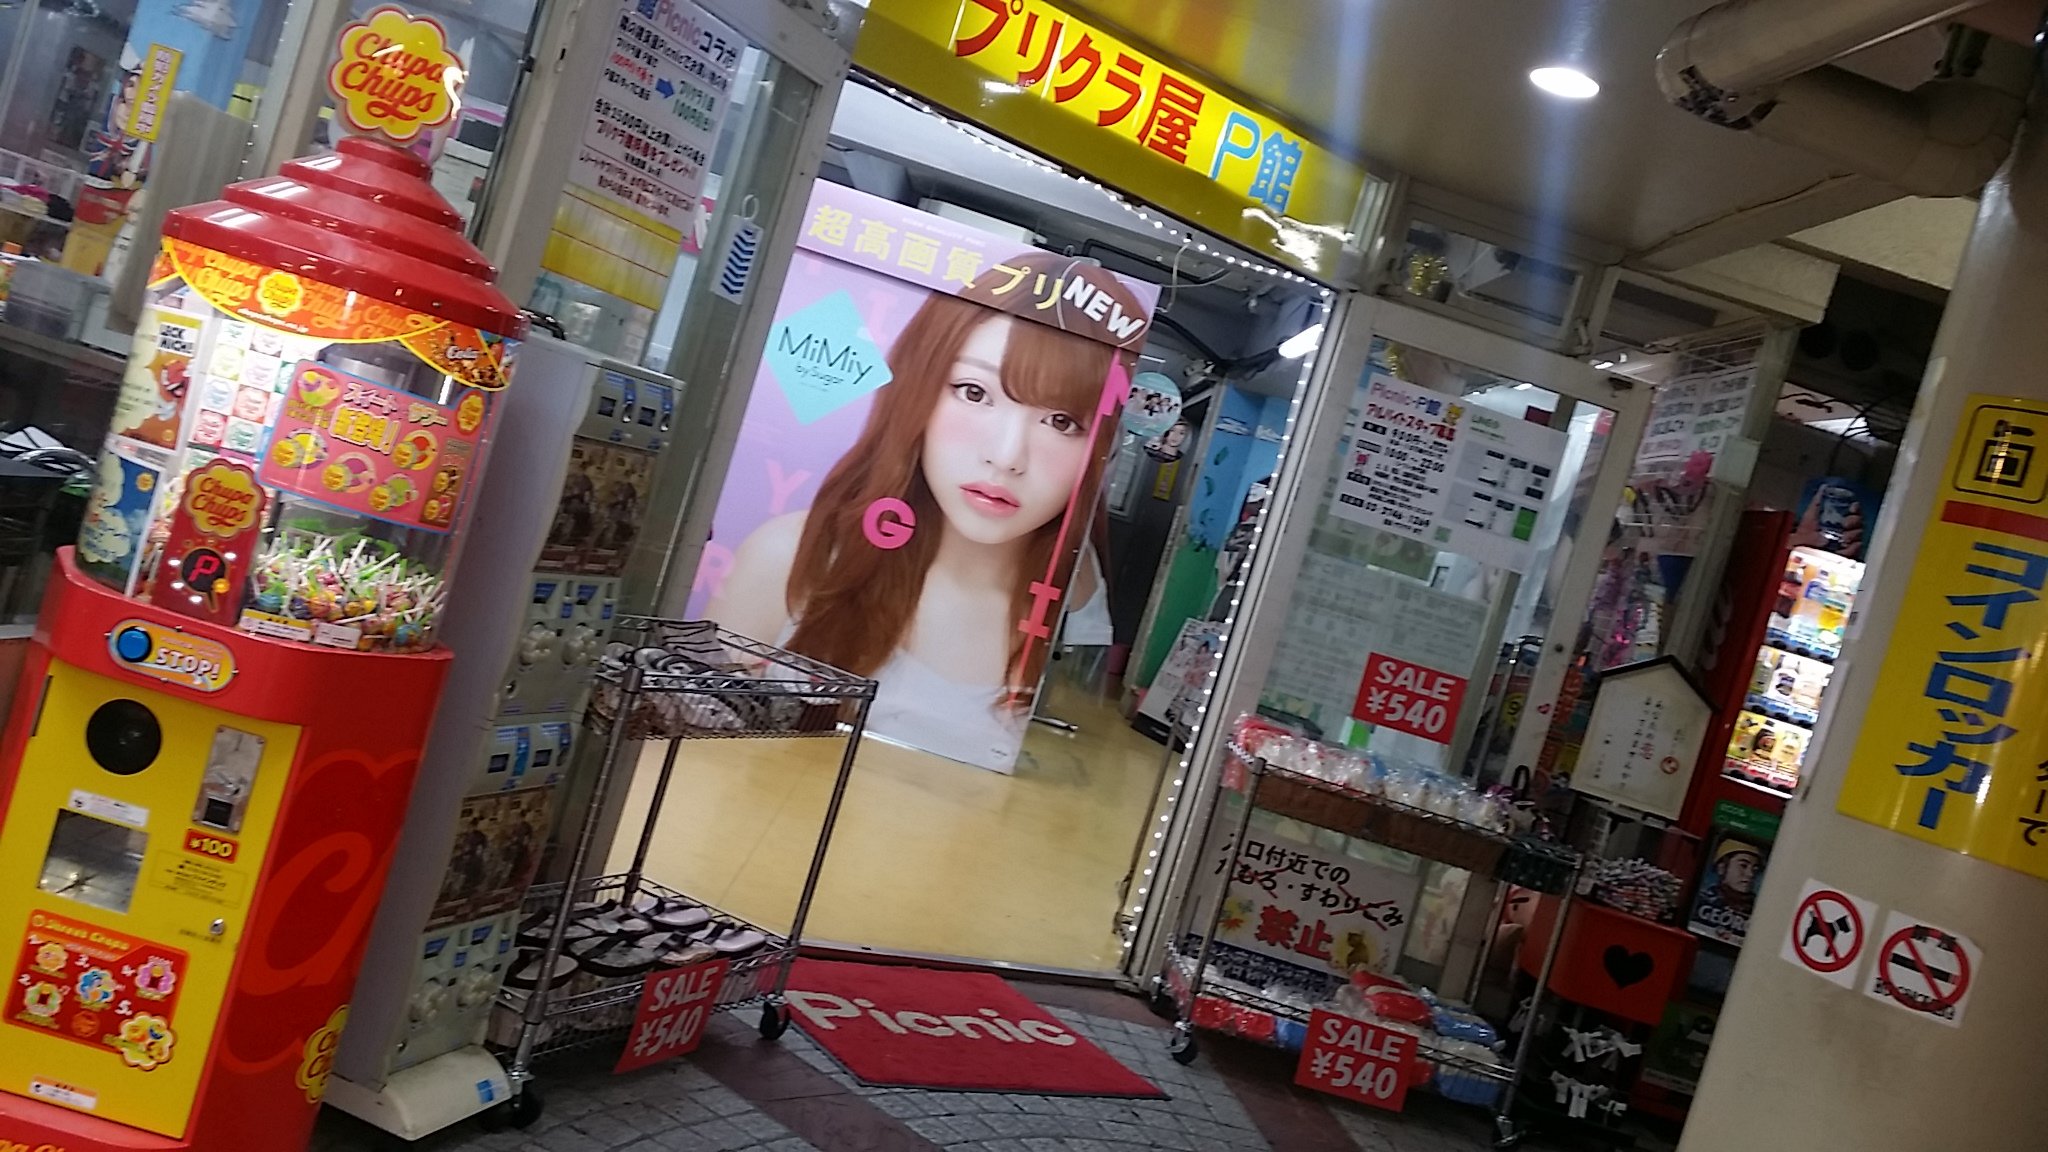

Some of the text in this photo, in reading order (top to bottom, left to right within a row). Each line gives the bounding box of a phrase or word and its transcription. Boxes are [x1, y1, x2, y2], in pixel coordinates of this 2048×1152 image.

[355, 32, 443, 83] Chupa
[341, 61, 437, 121] Chups
[956, 0, 1304, 213] プリクラ屋 P館
[808, 204, 1147, 341] 超高画質プリ NEW
[777, 325, 874, 384] MiMiy
[191, 494, 247, 527] Chups
[200, 477, 255, 505] Chupa
[862, 497, 917, 550] G
[155, 647, 221, 682] STOP!
[1374, 660, 1457, 702] SALE
[1895, 541, 2048, 831] コインロッカー
[1365, 687, 1449, 735] ¥540
[1254, 904, 1334, 961] 禁止
[651, 966, 720, 1013] SALE
[632, 1005, 703, 1062] ¥540
[784, 989, 1076, 1048] Picnic
[1320, 1017, 1407, 1064] SALE
[1310, 1046, 1398, 1101] ¥540
